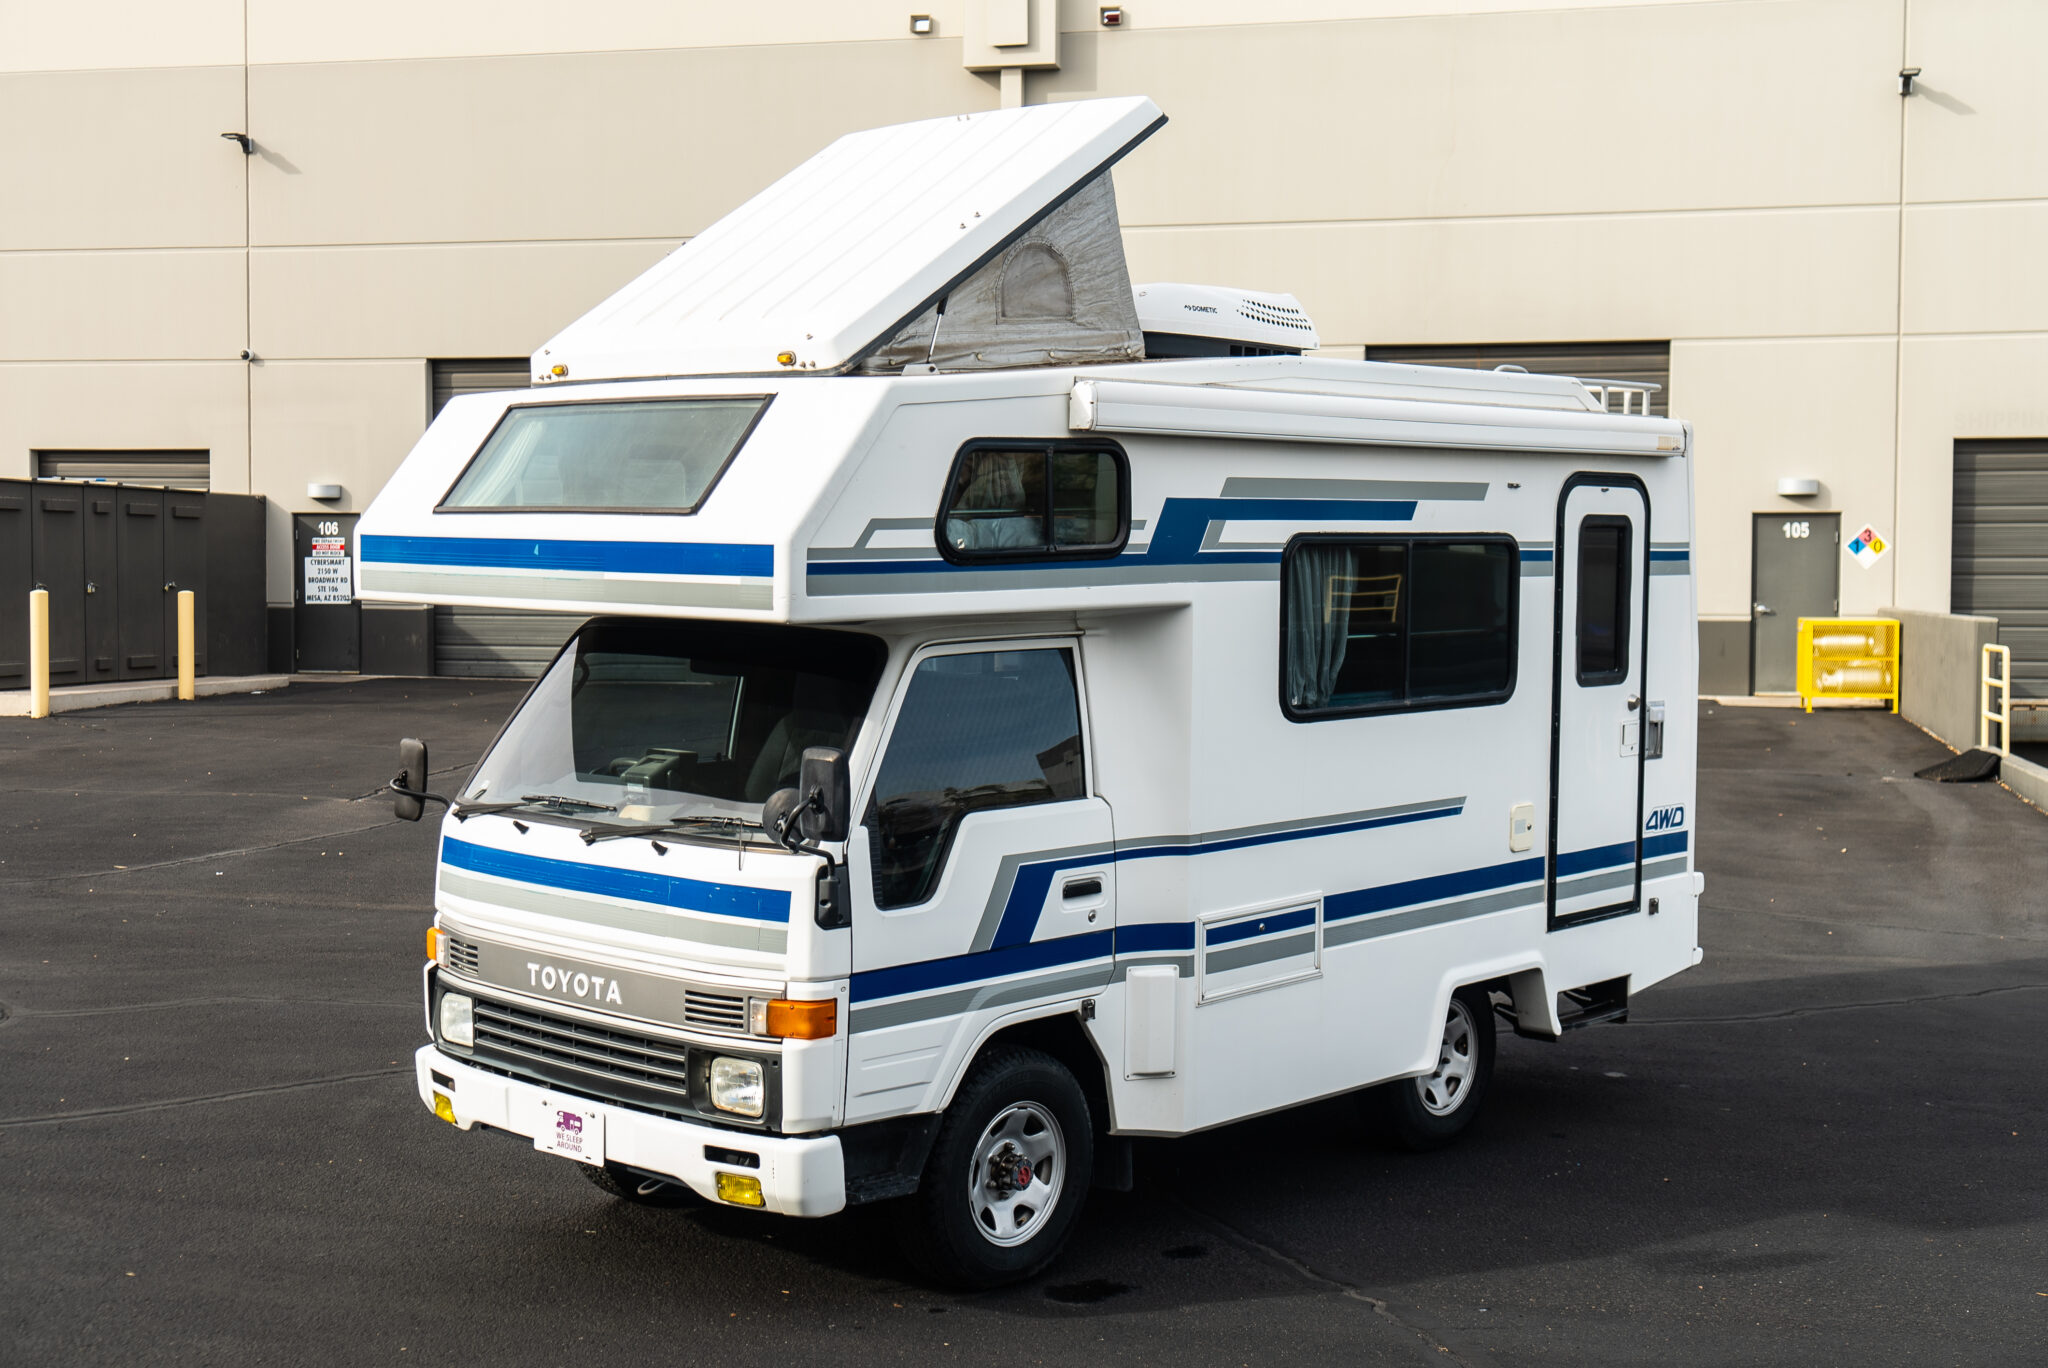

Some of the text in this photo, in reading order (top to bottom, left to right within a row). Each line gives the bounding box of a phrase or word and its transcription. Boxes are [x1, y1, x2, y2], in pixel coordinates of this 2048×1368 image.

[1191, 304, 1218, 314] DOMETIC
[318, 521, 339, 536] 106
[1782, 521, 1810, 538] 105
[1863, 529, 1872, 543] 3
[1854, 540, 1882, 553] 1 0
[527, 962, 622, 1005] TOYOTA
[556, 1131, 583, 1144] WE SLEEP
[557, 1140, 582, 1153] AROUND
